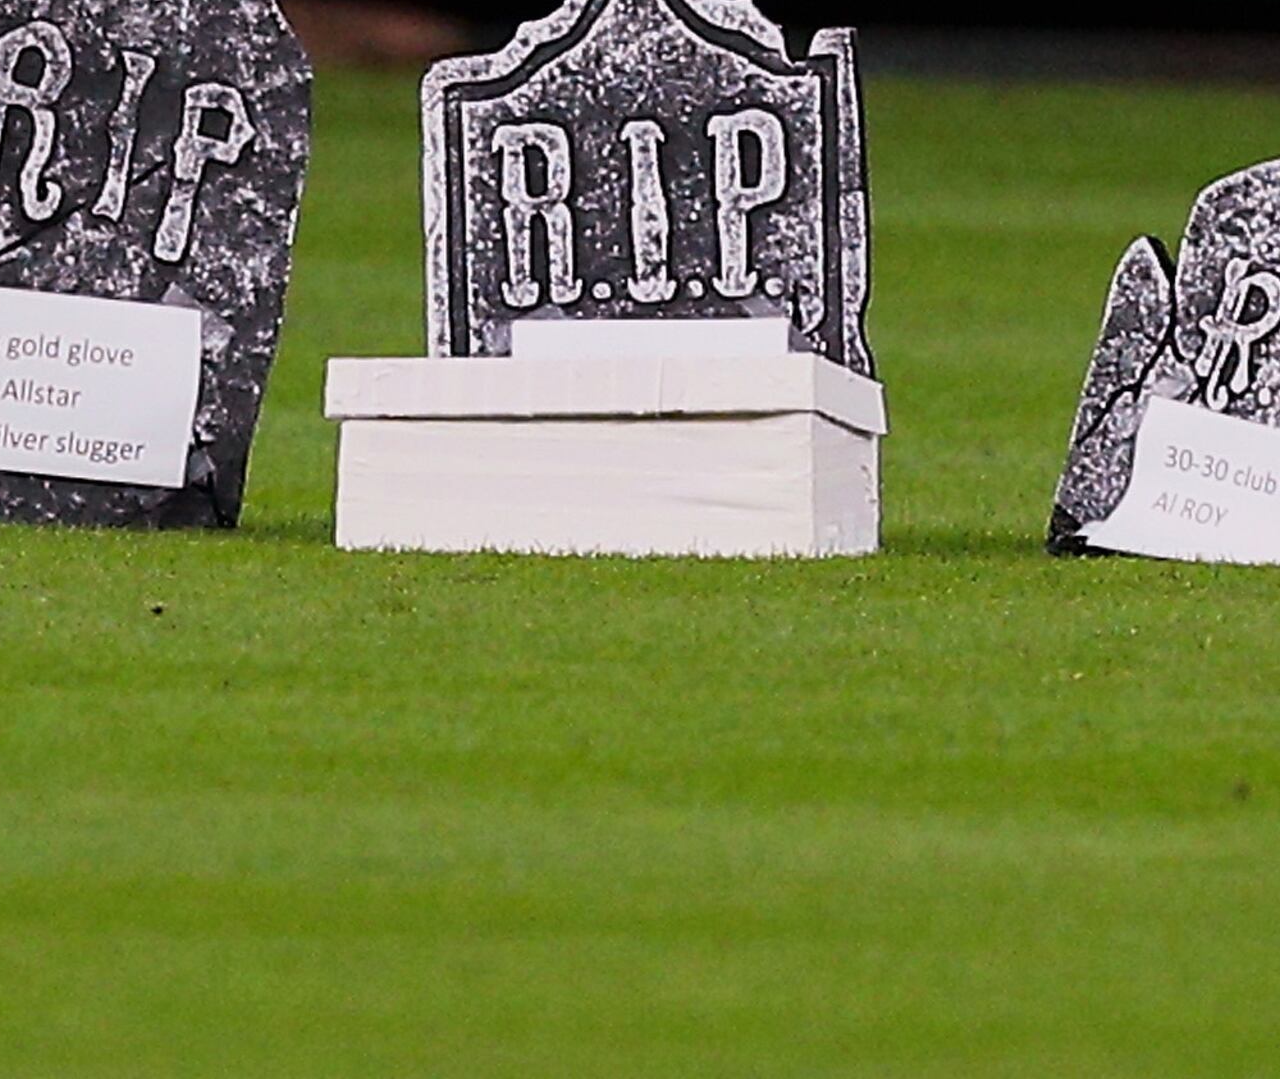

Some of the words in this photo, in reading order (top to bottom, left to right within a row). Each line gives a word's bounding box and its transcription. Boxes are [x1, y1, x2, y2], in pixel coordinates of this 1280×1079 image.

[6, 333, 61, 361] gold
[66, 338, 134, 367] glove
[1, 377, 82, 407] Allstar
[55, 430, 145, 464] slugger
[1164, 445, 1230, 481] 30-30
[1233, 466, 1277, 495] club
[1180, 498, 1229, 527] ROY
